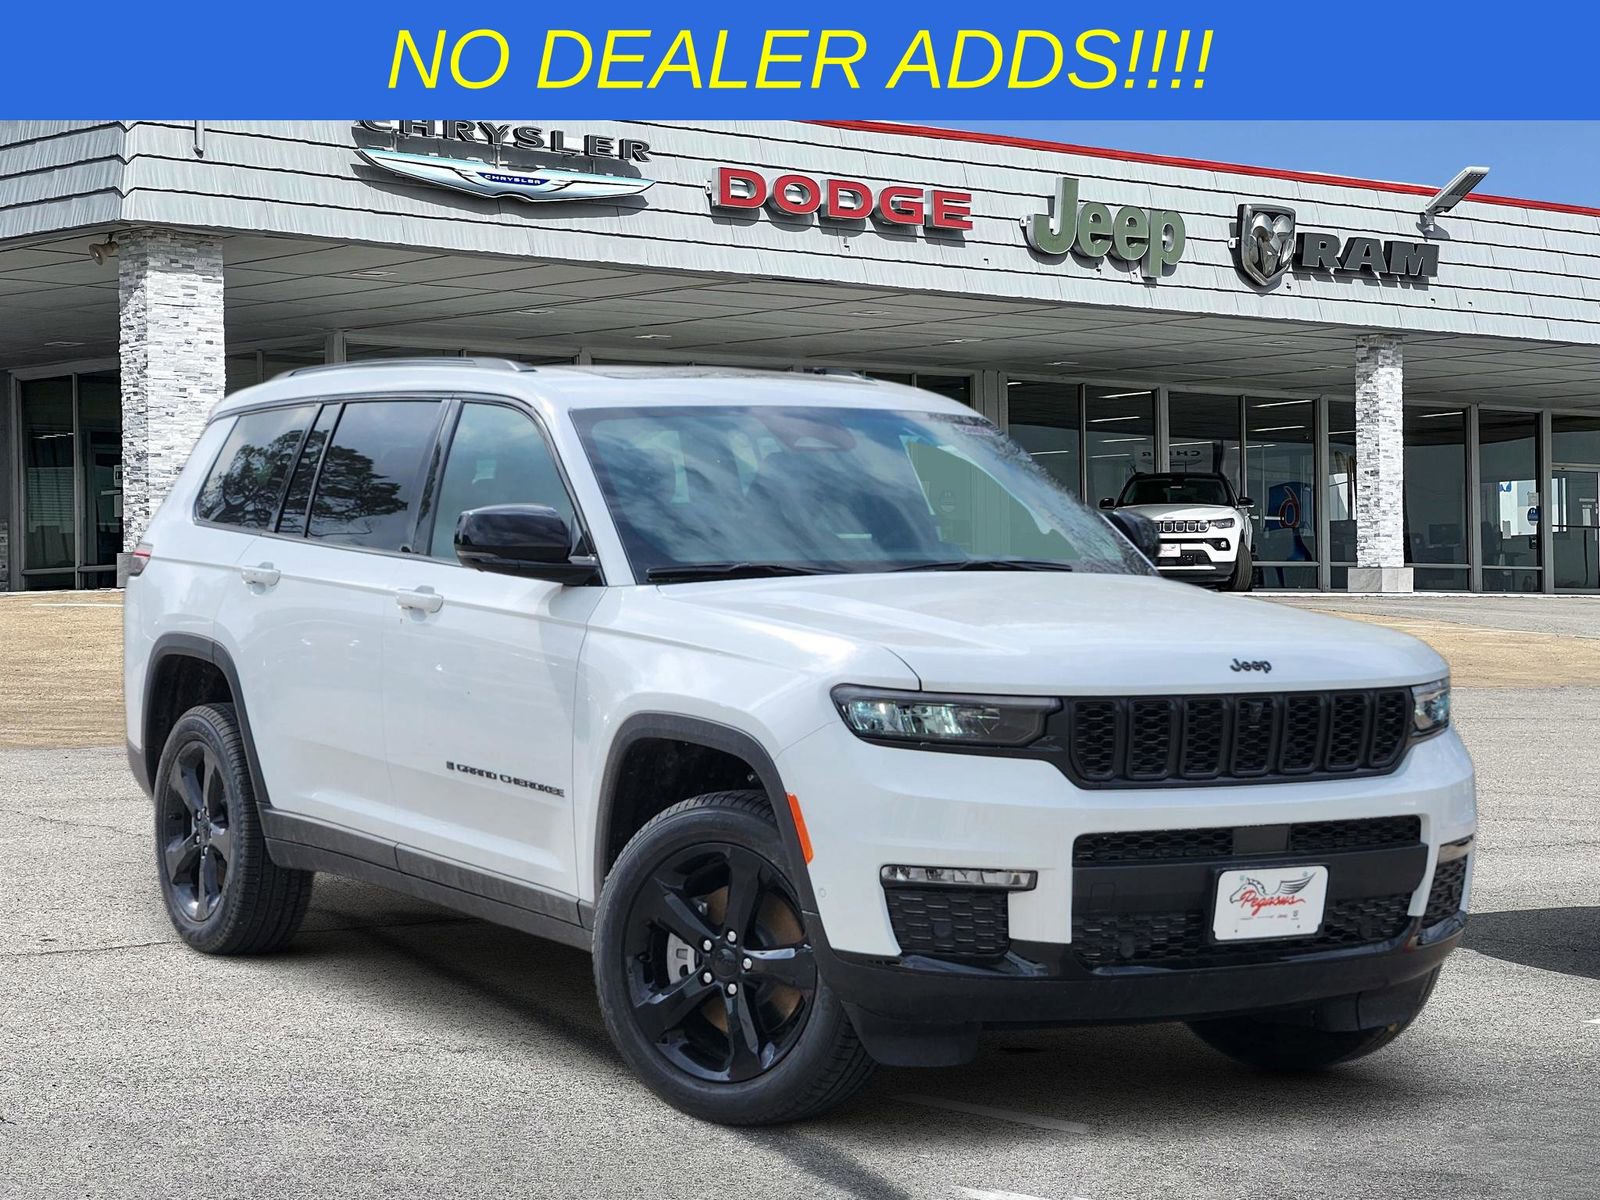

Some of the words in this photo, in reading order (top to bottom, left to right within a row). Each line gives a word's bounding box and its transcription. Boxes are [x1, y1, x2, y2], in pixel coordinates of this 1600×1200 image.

[484, 174, 541, 185] CHRYSLER
[712, 166, 974, 231] DODGE
[1026, 177, 1186, 279] Jeep
[1296, 231, 1440, 277] RAM
[1229, 658, 1273, 674] Jeep
[1240, 889, 1306, 917] Pegasus
